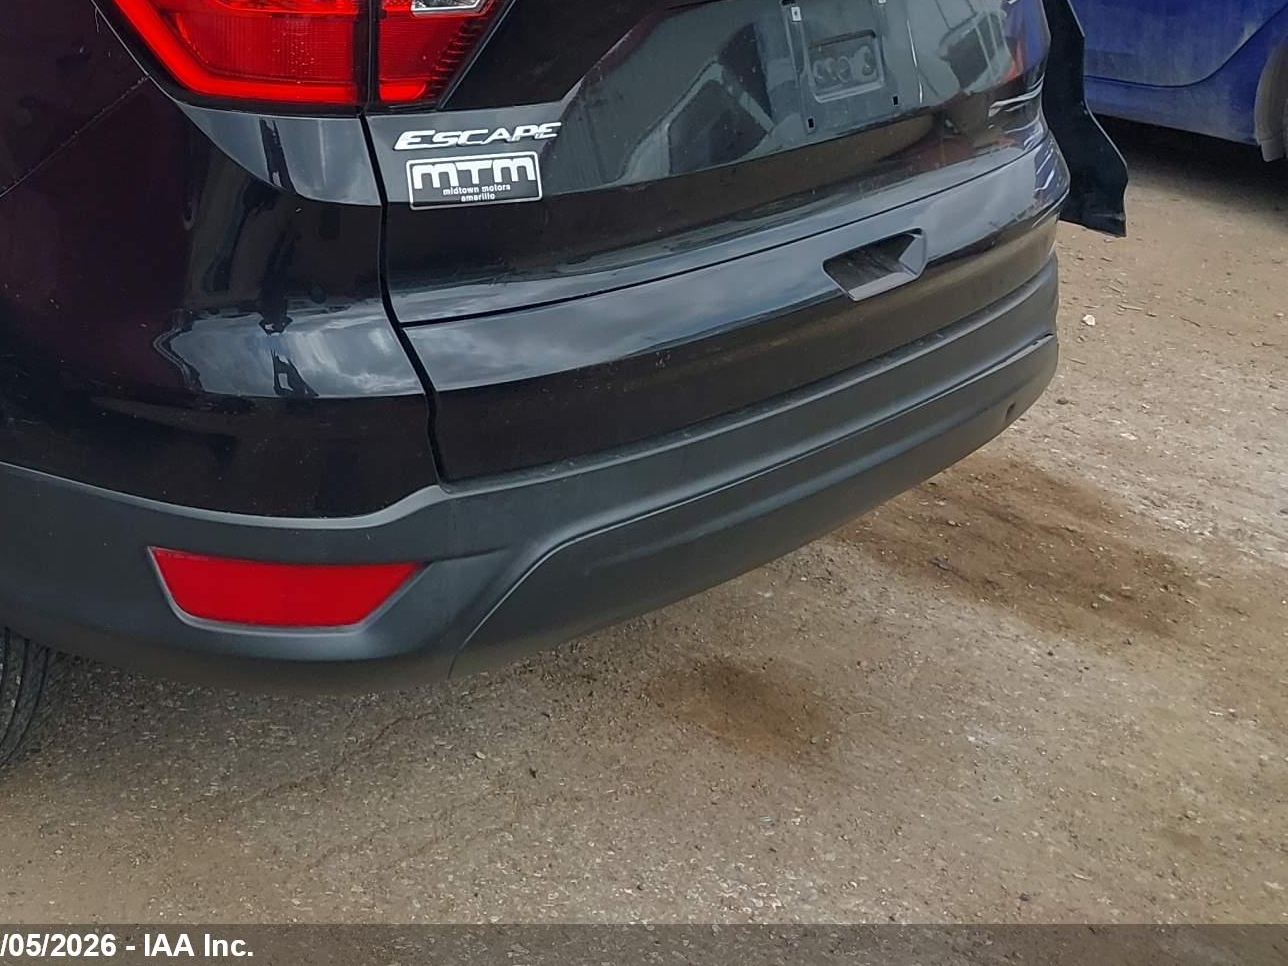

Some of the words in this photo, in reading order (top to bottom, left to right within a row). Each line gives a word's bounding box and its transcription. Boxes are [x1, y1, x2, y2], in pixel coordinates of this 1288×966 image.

[393, 121, 562, 151] ESCAPE
[442, 186, 480, 196] midtown
[481, 183, 511, 193] motors
[460, 192, 496, 202] amarillo
